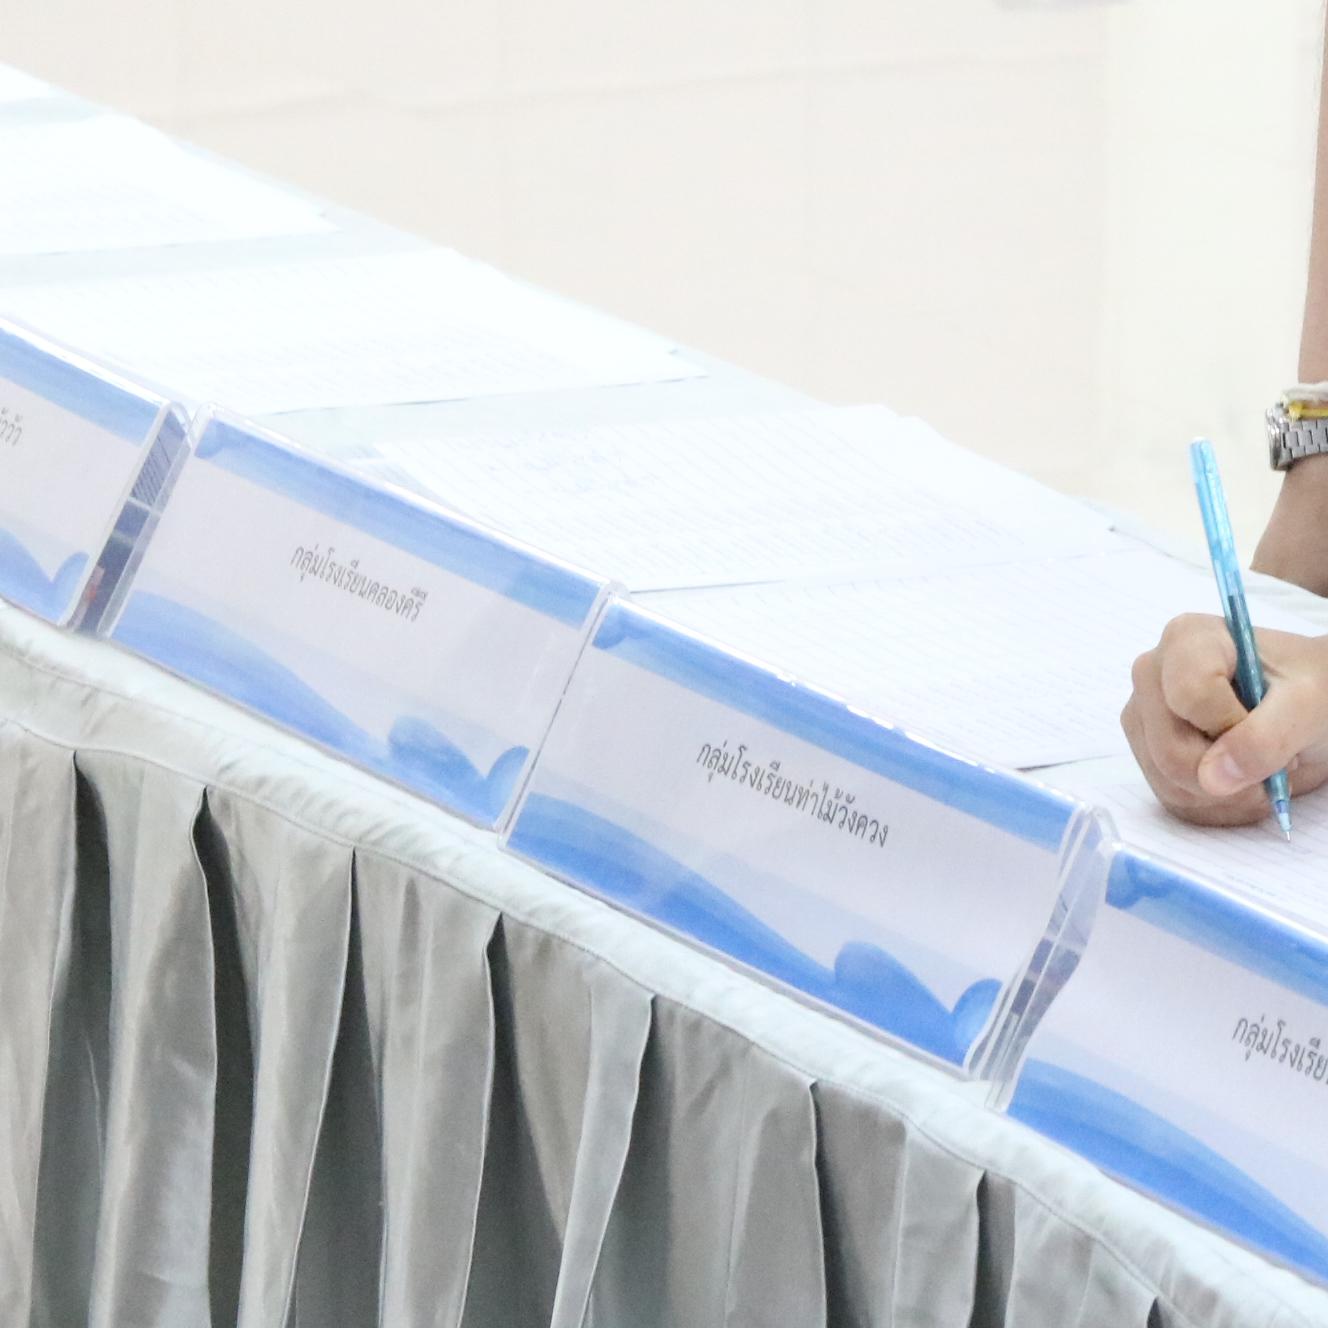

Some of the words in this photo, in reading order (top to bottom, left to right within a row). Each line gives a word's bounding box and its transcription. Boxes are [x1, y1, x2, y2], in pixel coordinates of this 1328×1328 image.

[696, 739, 889, 848] กลุ่มโรงเรียนท่าไม้วังควง
